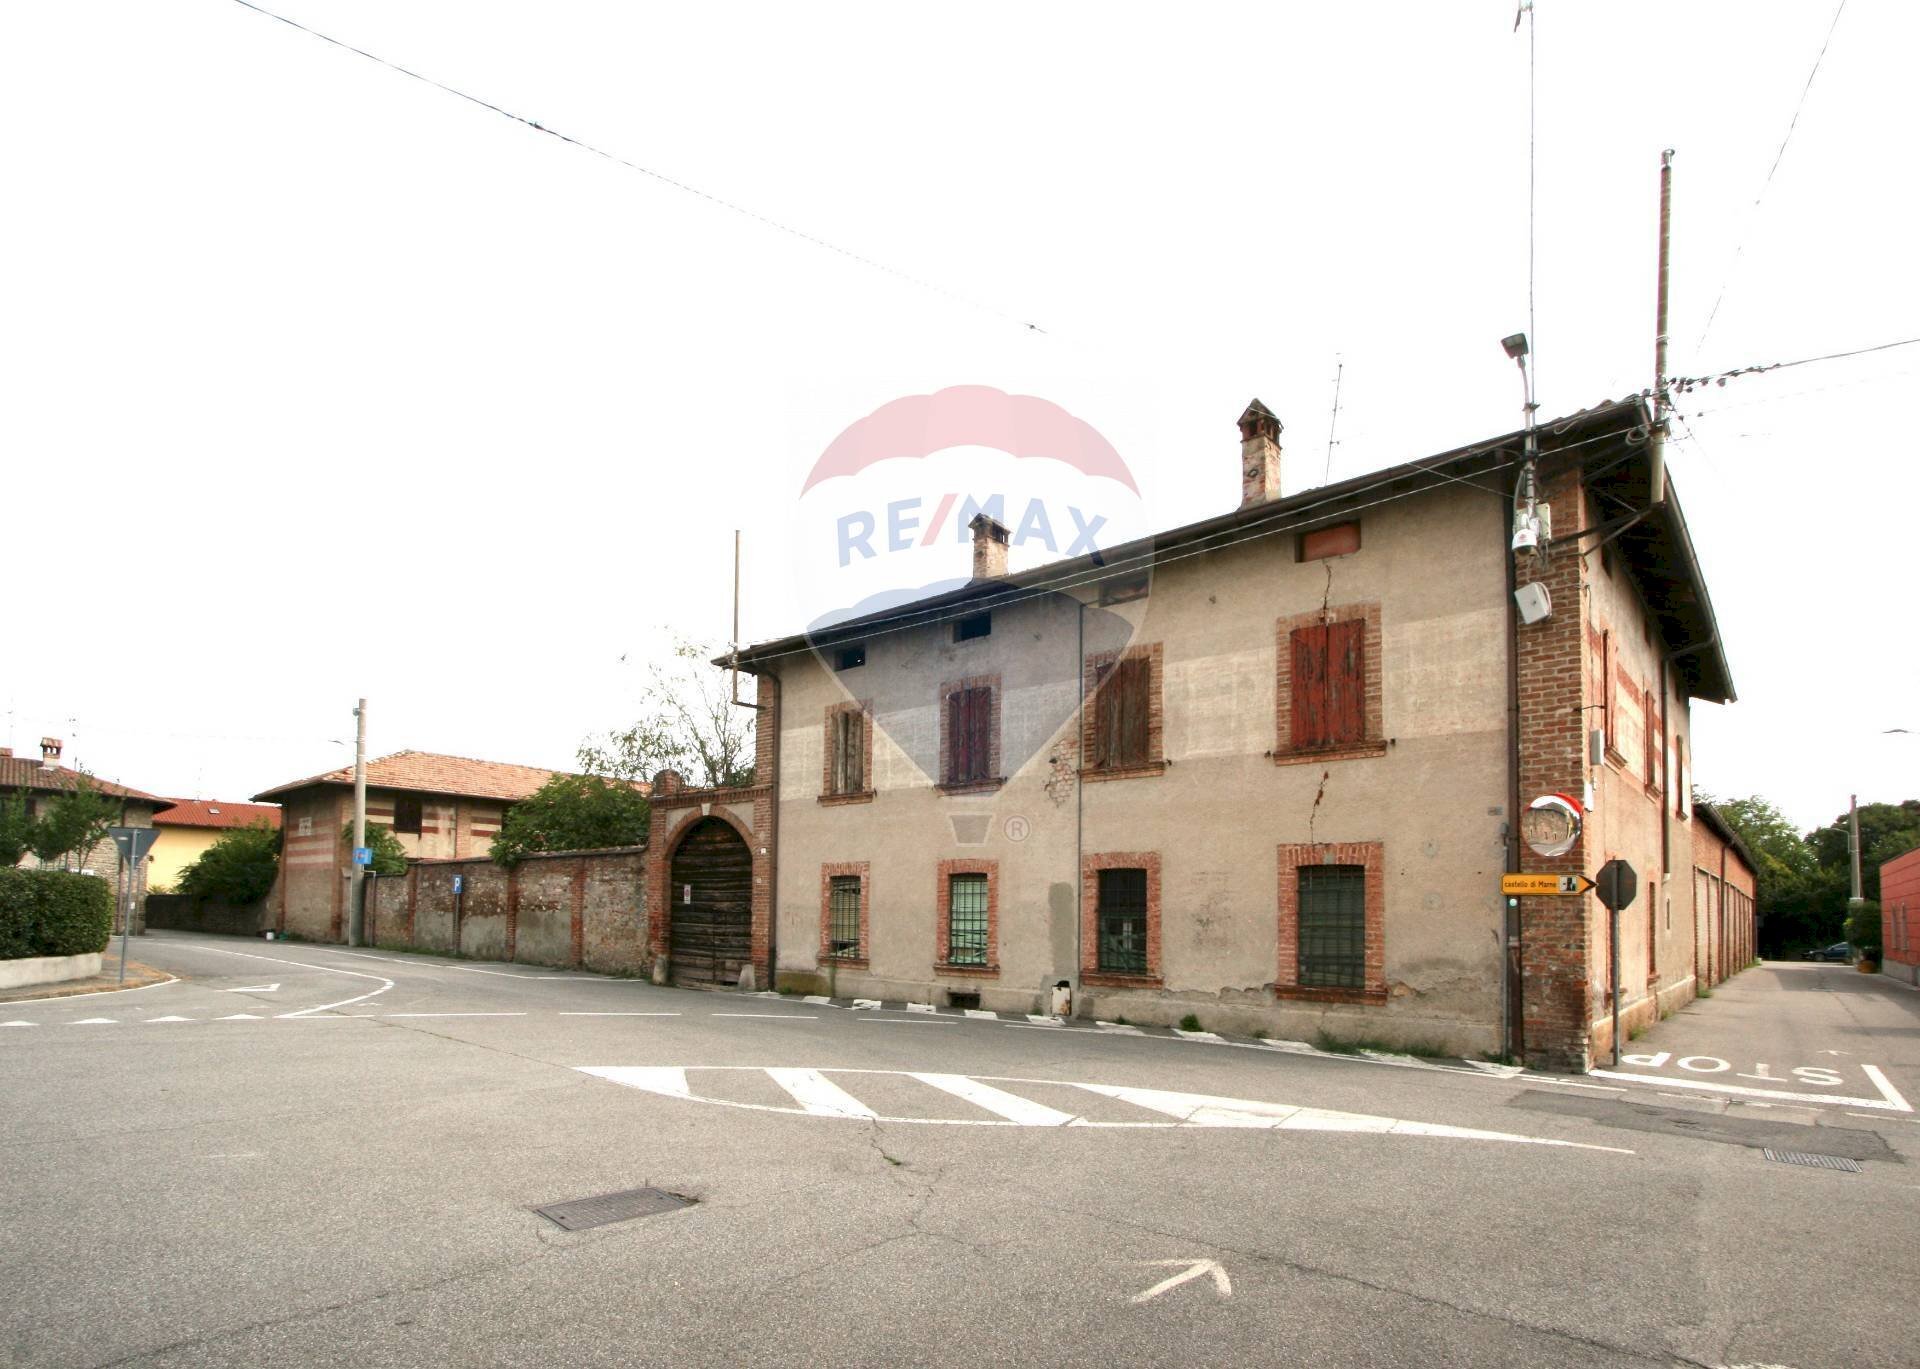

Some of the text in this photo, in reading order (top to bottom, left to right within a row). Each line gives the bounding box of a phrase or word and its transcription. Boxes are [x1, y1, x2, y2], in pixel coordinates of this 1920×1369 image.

[454, 877, 461, 891] P
[1504, 880, 1528, 888] castello
[1530, 880, 1537, 888] di
[1620, 1052, 1844, 1086] STOP
